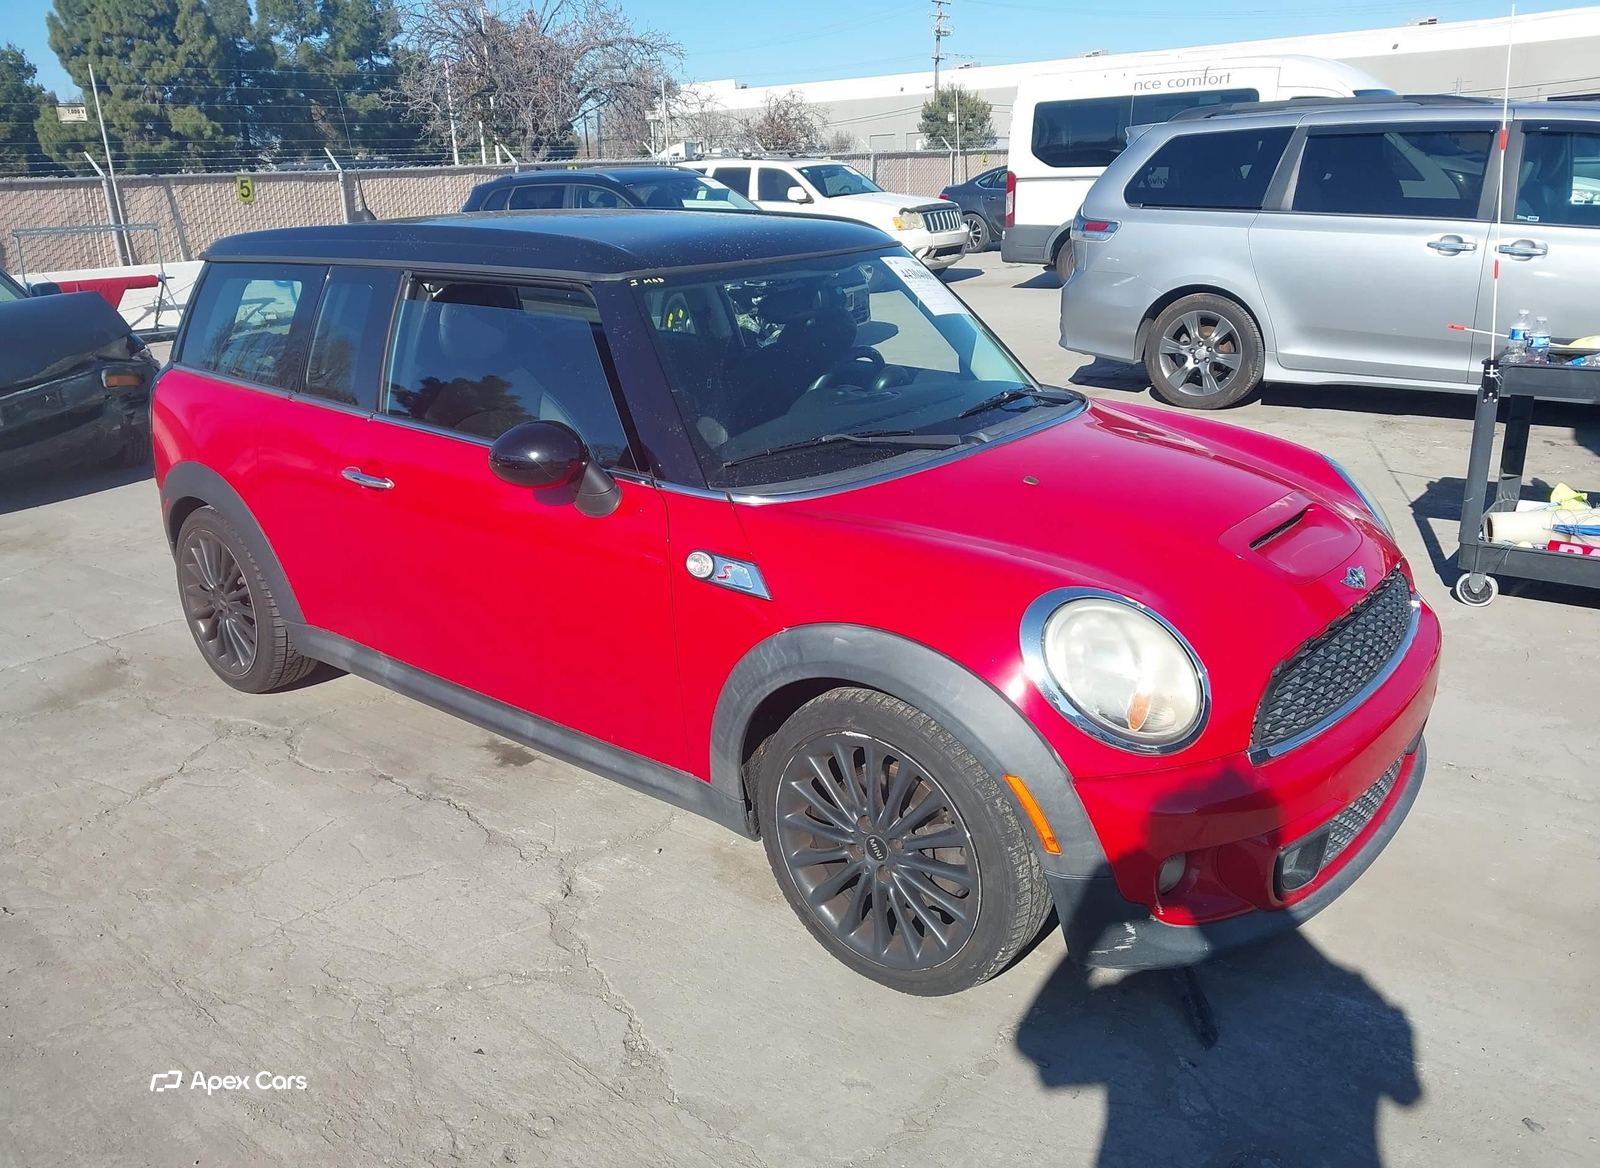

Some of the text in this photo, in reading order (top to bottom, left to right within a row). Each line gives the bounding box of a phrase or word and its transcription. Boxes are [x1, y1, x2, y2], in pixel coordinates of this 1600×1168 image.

[1167, 66, 1232, 88] comfort
[240, 179, 251, 198] 5
[716, 565, 733, 580] S
[869, 838, 884, 860] MINI
